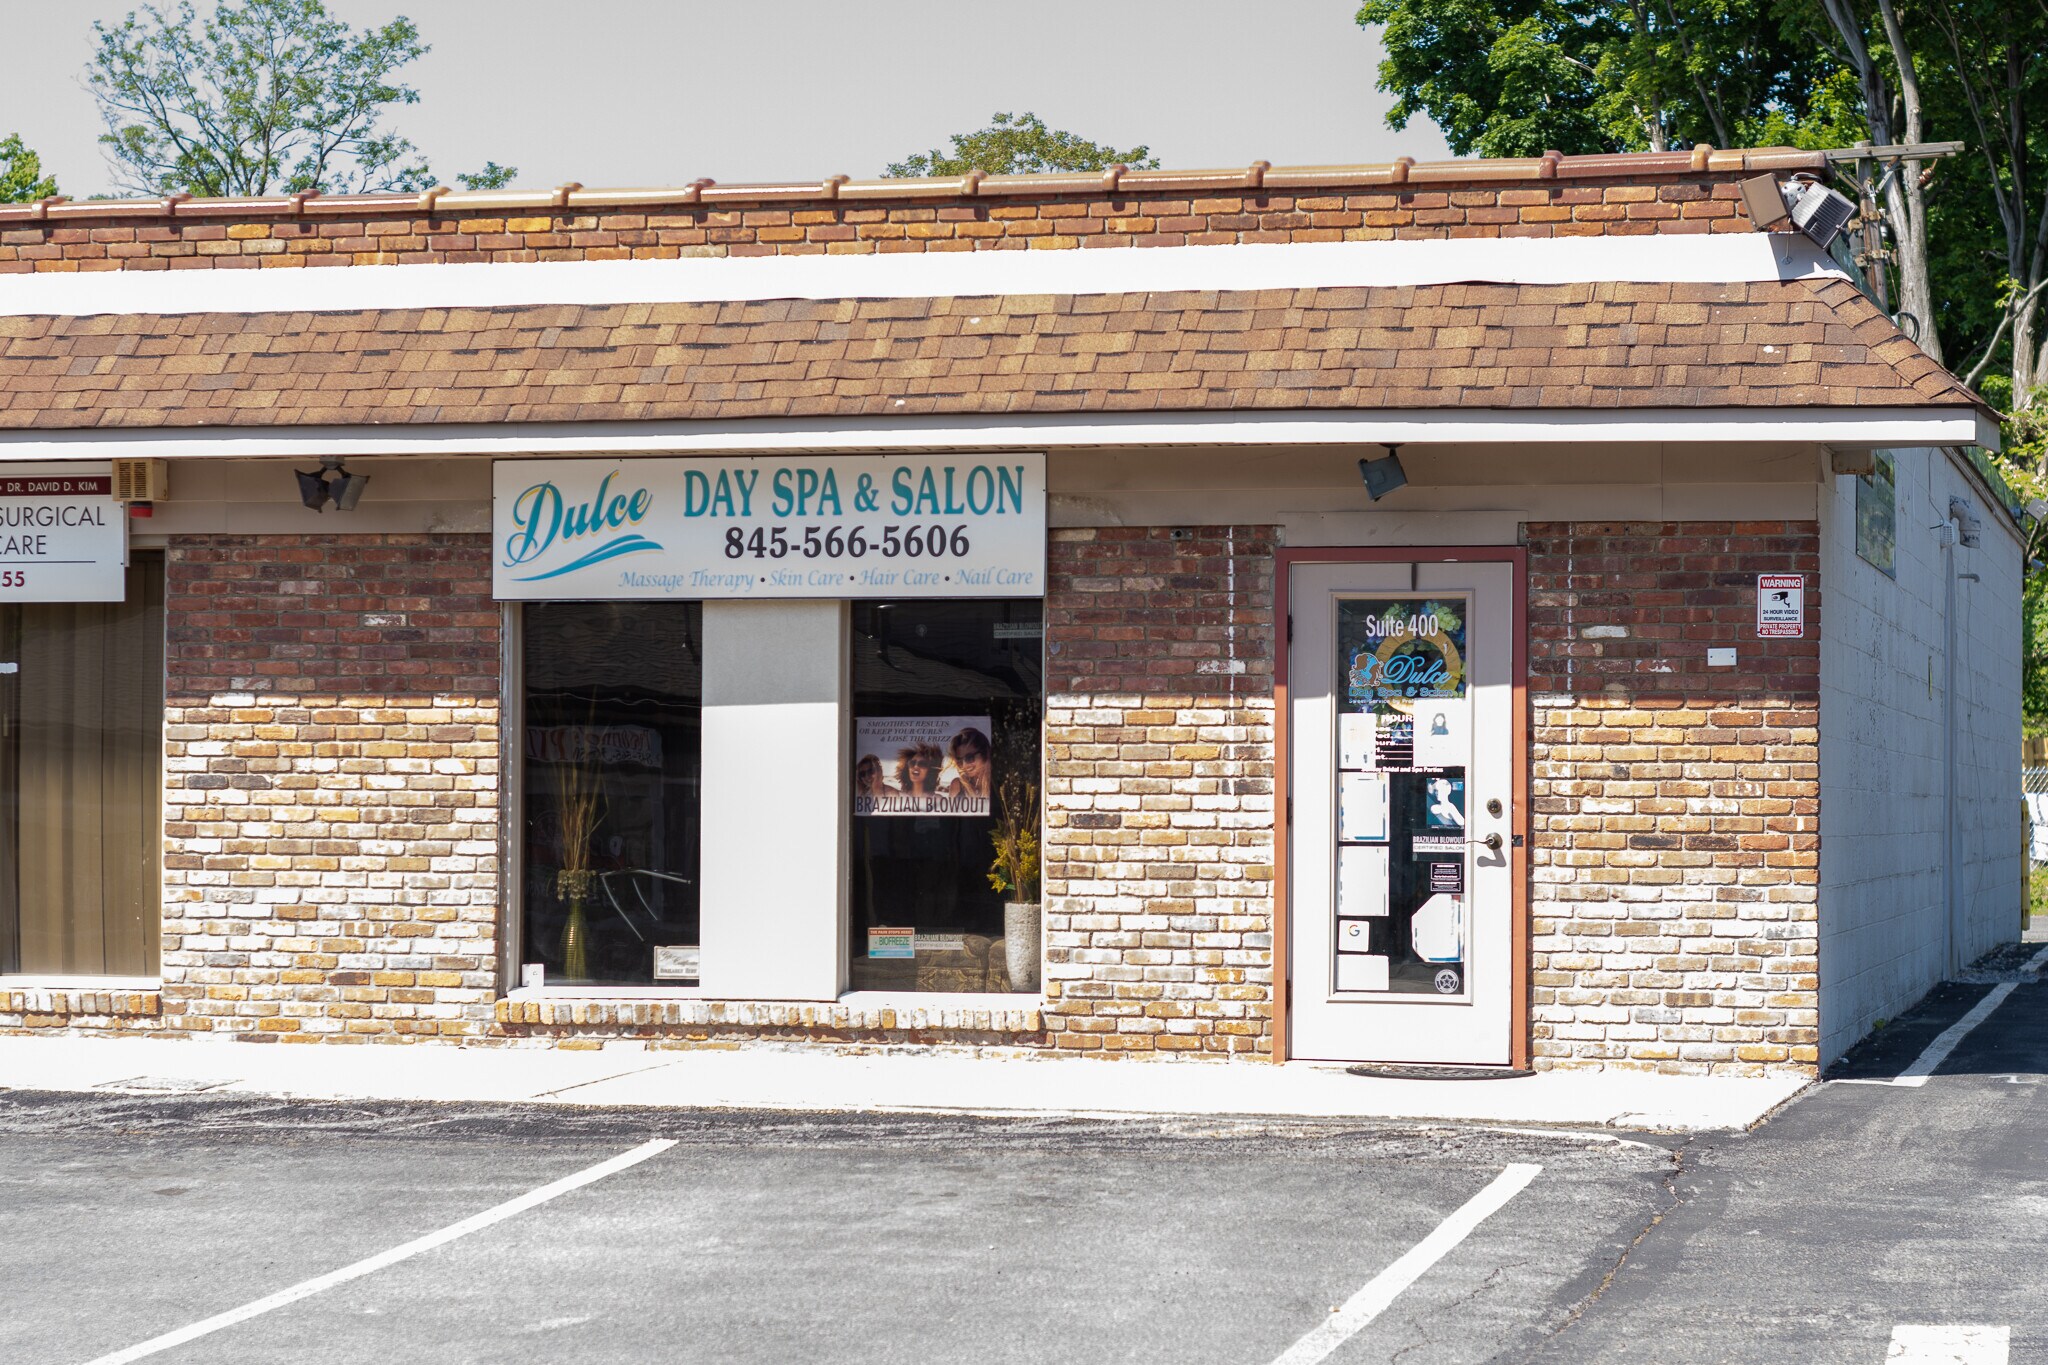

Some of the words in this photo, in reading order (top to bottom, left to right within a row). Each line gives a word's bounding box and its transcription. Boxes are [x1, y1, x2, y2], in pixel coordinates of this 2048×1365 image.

[7, 482, 24, 493] DR.
[28, 481, 60, 493] DAVID
[63, 482, 75, 492] D.
[78, 481, 98, 492] KIM
[683, 468, 759, 517] DAY
[772, 467, 843, 518] SPA
[854, 472, 880, 513] &
[891, 465, 1025, 517] SALON
[502, 468, 653, 568] Dulce
[0, 534, 47, 555] ARE
[725, 524, 970, 559] 845-566-5606
[2, 570, 26, 588] 55
[618, 570, 684, 593] Massage
[689, 568, 756, 593] Therapy
[769, 567, 803, 587] Skin
[808, 569, 844, 586] Care
[858, 566, 900, 586] Hair
[903, 568, 940, 585] Care
[954, 565, 996, 586] Nail
[996, 568, 1033, 585] Care
[1761, 579, 1801, 588] WARNING
[1366, 614, 1405, 638] Suite
[1408, 614, 1439, 637] 400
[1381, 654, 1453, 684] Dulce
[1348, 687, 1374, 701] Day
[1377, 686, 1403, 700] Spa
[1406, 686, 1417, 697] &
[1419, 686, 1454, 697] Salon
[867, 720, 914, 728] SMOOTHEST
[1381, 714, 1415, 722] HOUR
[1411, 766, 1423, 774] Spa
[857, 796, 921, 813] BRAZILIAN
[925, 796, 987, 813] BLOWOUT
[878, 936, 910, 946] BIOFREEZE
[915, 934, 939, 942] BRAZILIAN
[940, 934, 963, 942] BLOWOUT
